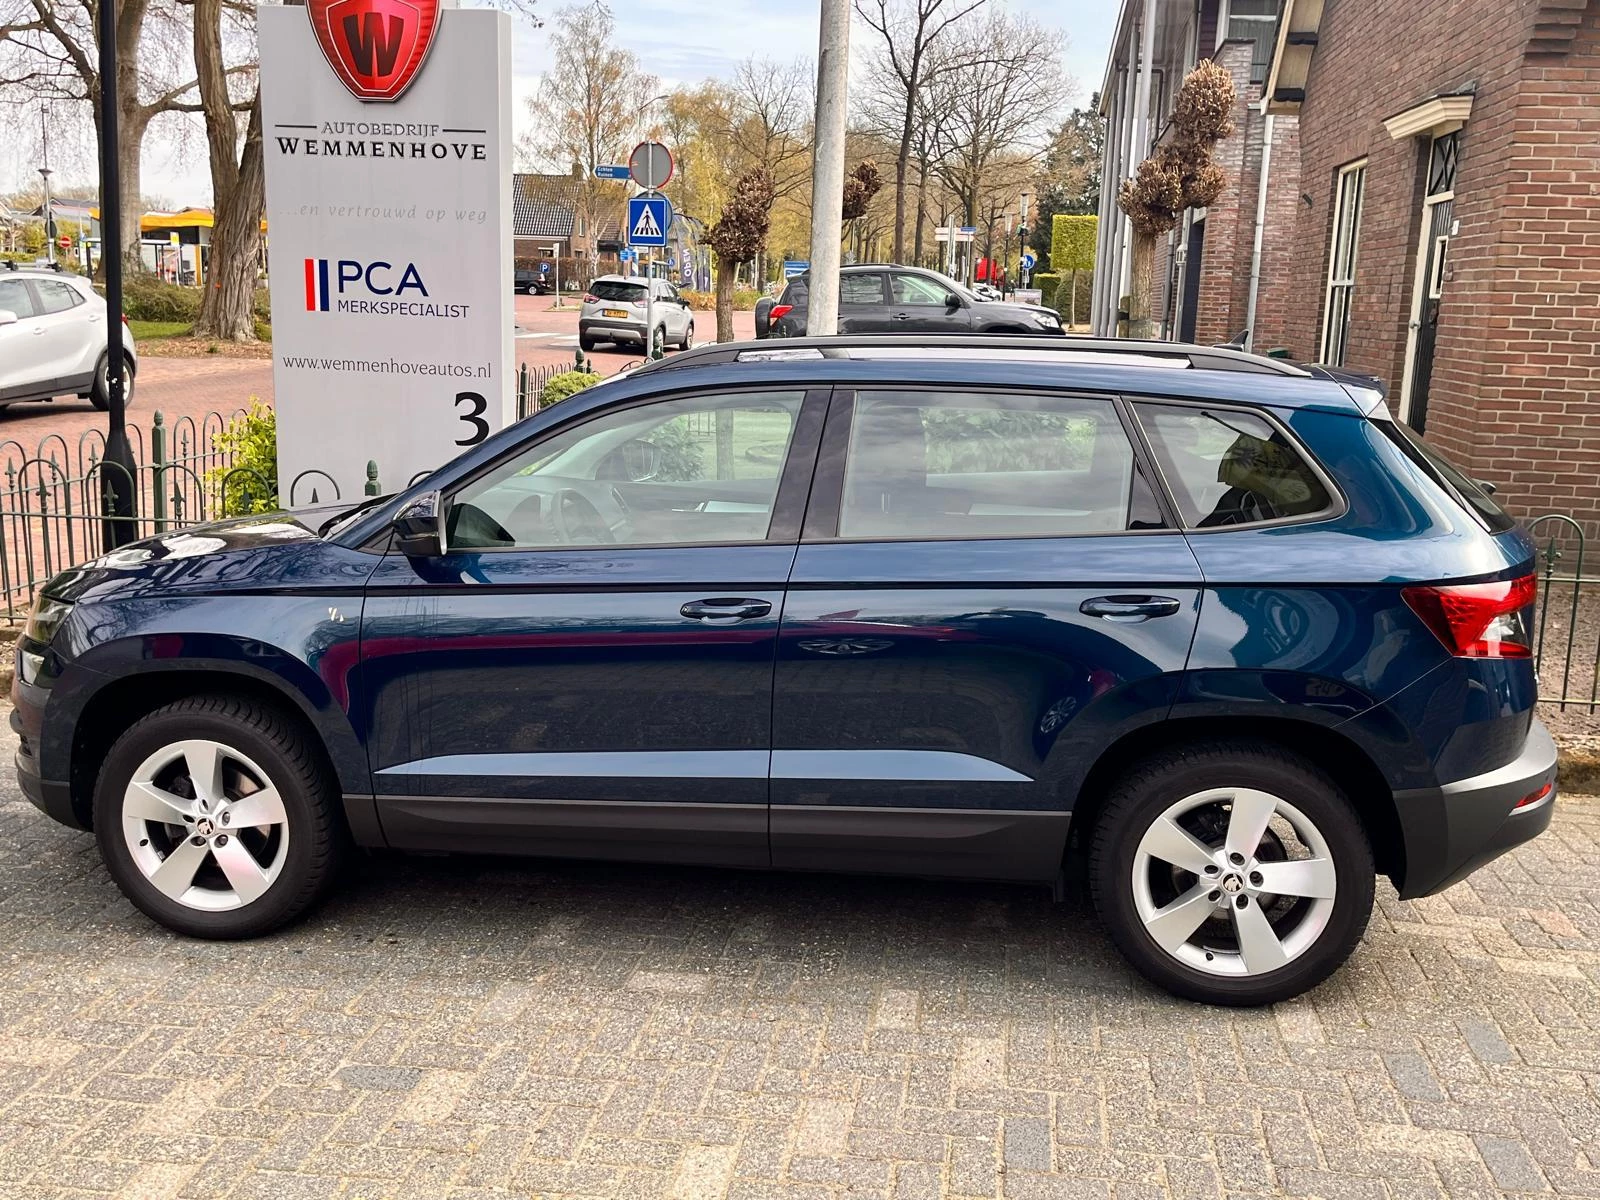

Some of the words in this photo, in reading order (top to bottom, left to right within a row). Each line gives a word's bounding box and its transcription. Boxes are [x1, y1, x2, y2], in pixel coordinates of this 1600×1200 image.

[342, 12, 405, 77] W
[321, 121, 440, 137] AUTOBEDRIJF
[276, 137, 487, 161] WEMMENHOVE
[329, 204, 416, 220] vertrouwd
[425, 209, 447, 223] op
[454, 210, 487, 225] weg
[337, 260, 429, 297] PCA
[337, 300, 470, 319] MERKSPECIALIST
[283, 356, 492, 379] www.wemmenhoveautos.nl
[454, 391, 490, 447] 3
